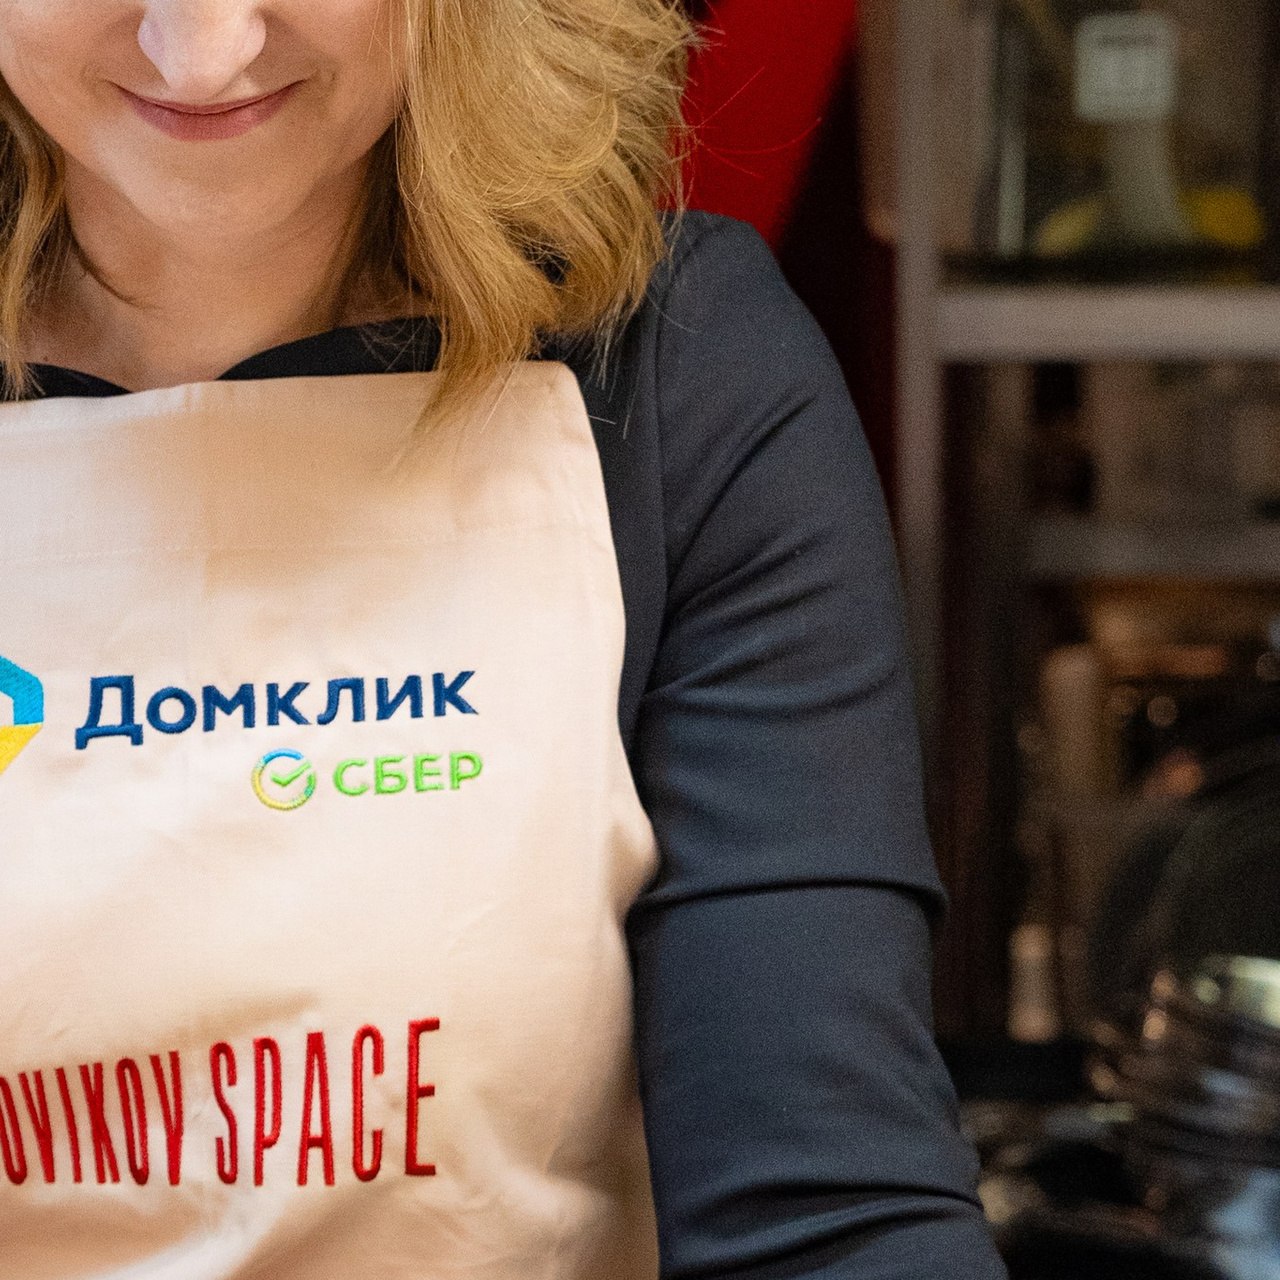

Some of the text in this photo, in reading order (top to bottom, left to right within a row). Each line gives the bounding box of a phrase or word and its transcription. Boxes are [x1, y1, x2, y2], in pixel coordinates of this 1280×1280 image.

[74, 670, 478, 750] Домклик
[333, 751, 483, 797] СБЕР
[210, 1017, 440, 1187] SPACE
